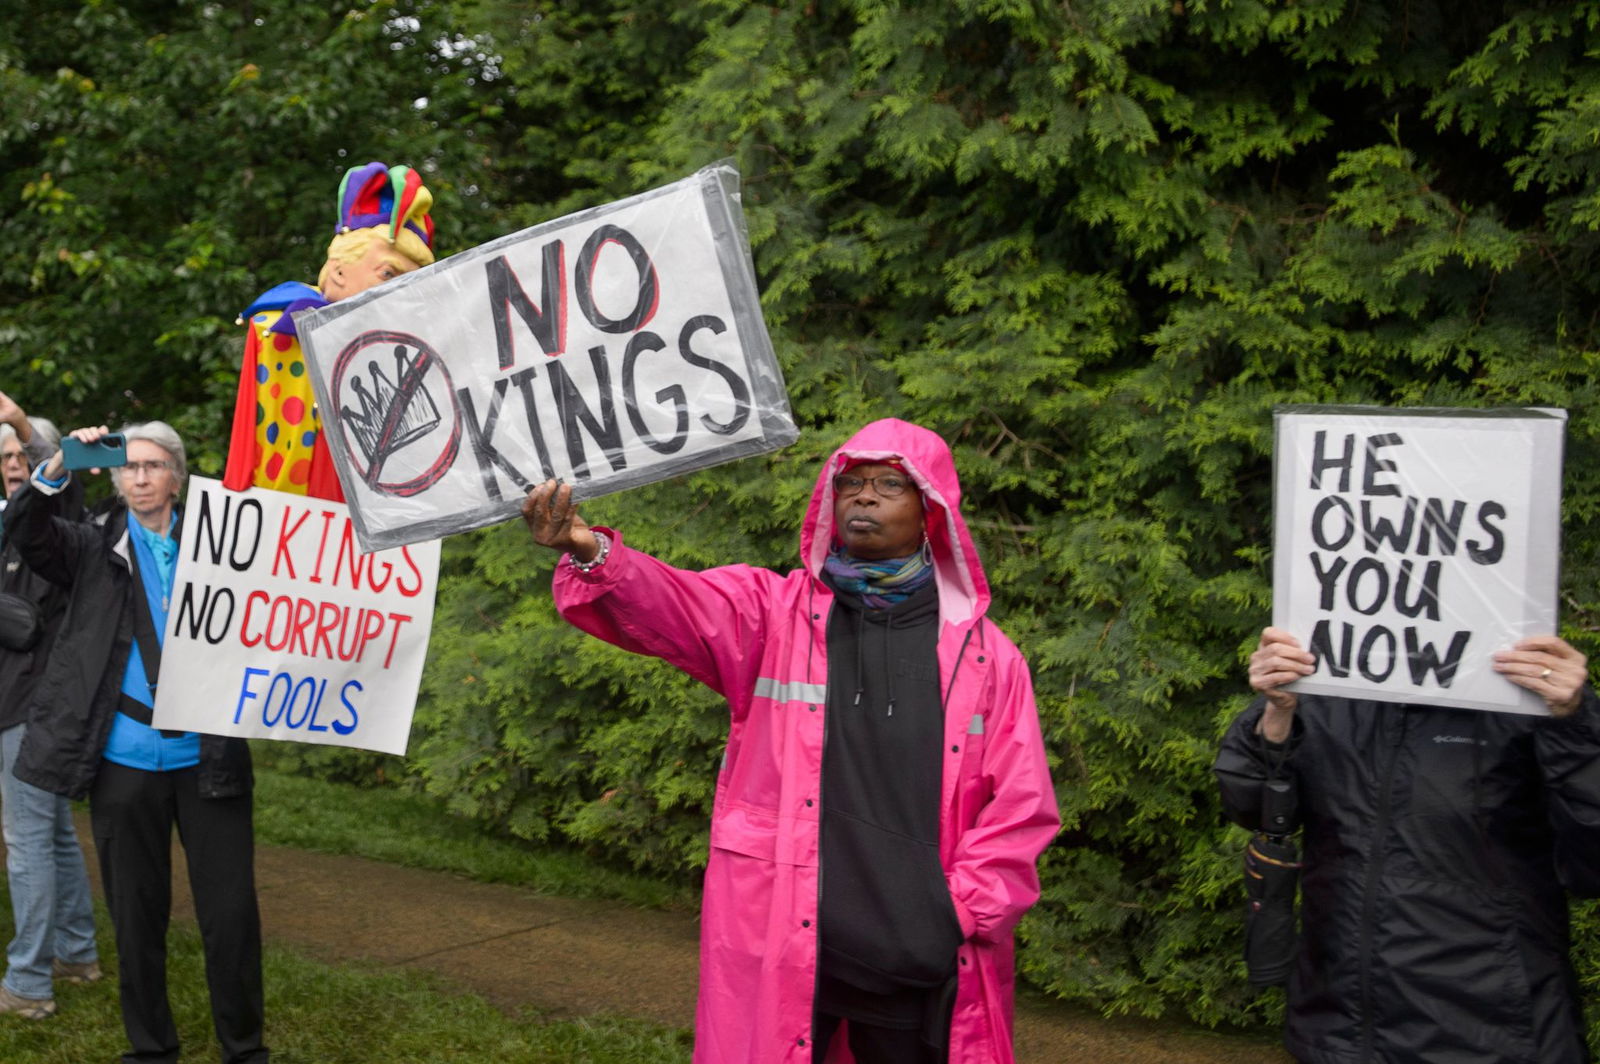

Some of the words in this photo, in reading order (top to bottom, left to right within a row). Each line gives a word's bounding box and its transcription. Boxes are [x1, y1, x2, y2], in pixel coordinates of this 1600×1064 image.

[485, 223, 660, 371] NO
[457, 314, 751, 501] KINGS
[1310, 430, 1404, 497] HE
[193, 490, 263, 572] NO
[1311, 494, 1506, 566] OWNS
[1309, 551, 1441, 621] YOU
[174, 581, 236, 645] NO
[239, 590, 412, 669] CORRUPT
[1309, 619, 1472, 689] NOW
[233, 667, 363, 735] FOOLS
